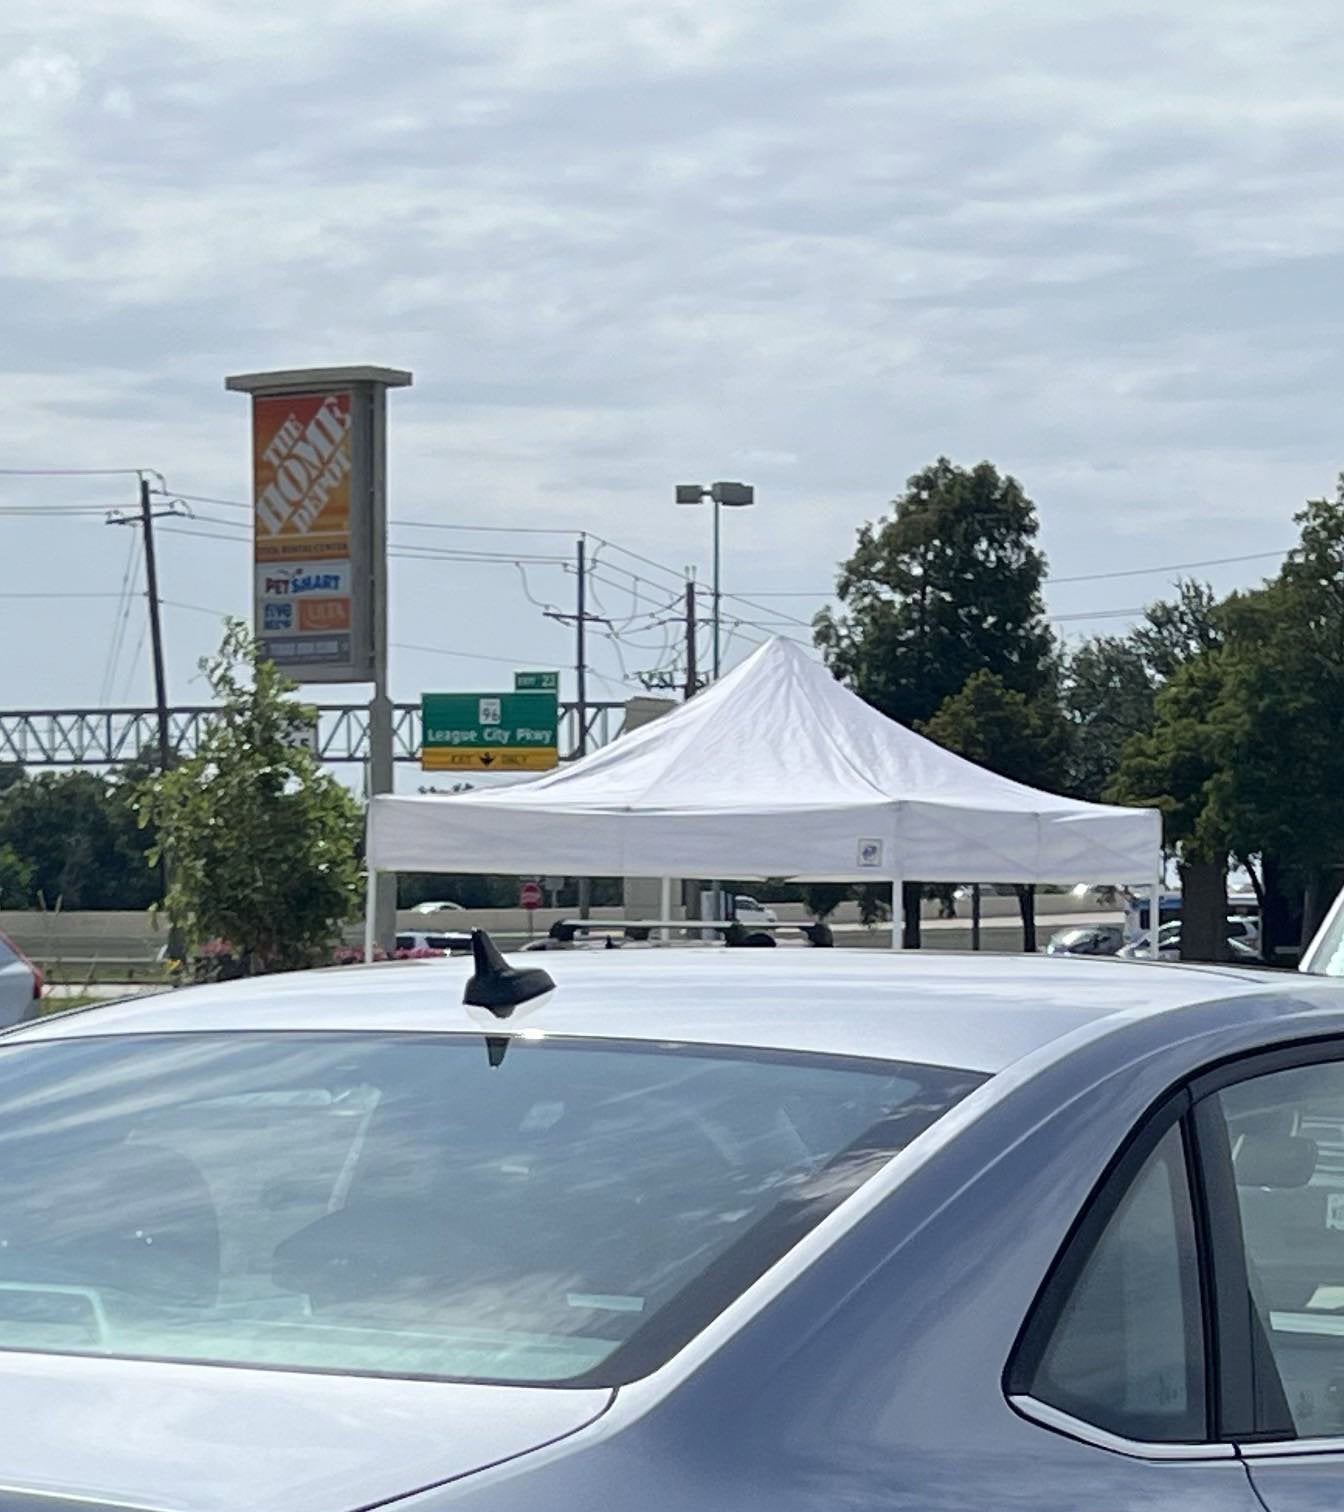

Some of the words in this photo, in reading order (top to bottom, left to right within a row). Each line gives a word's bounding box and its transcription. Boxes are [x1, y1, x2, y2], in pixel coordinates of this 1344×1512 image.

[256, 397, 351, 536] HOME
[262, 413, 304, 466] THE
[291, 448, 351, 534] DEPOT
[427, 729, 477, 744] League
[483, 728, 511, 744] City
[516, 728, 553, 744] Pkwy
